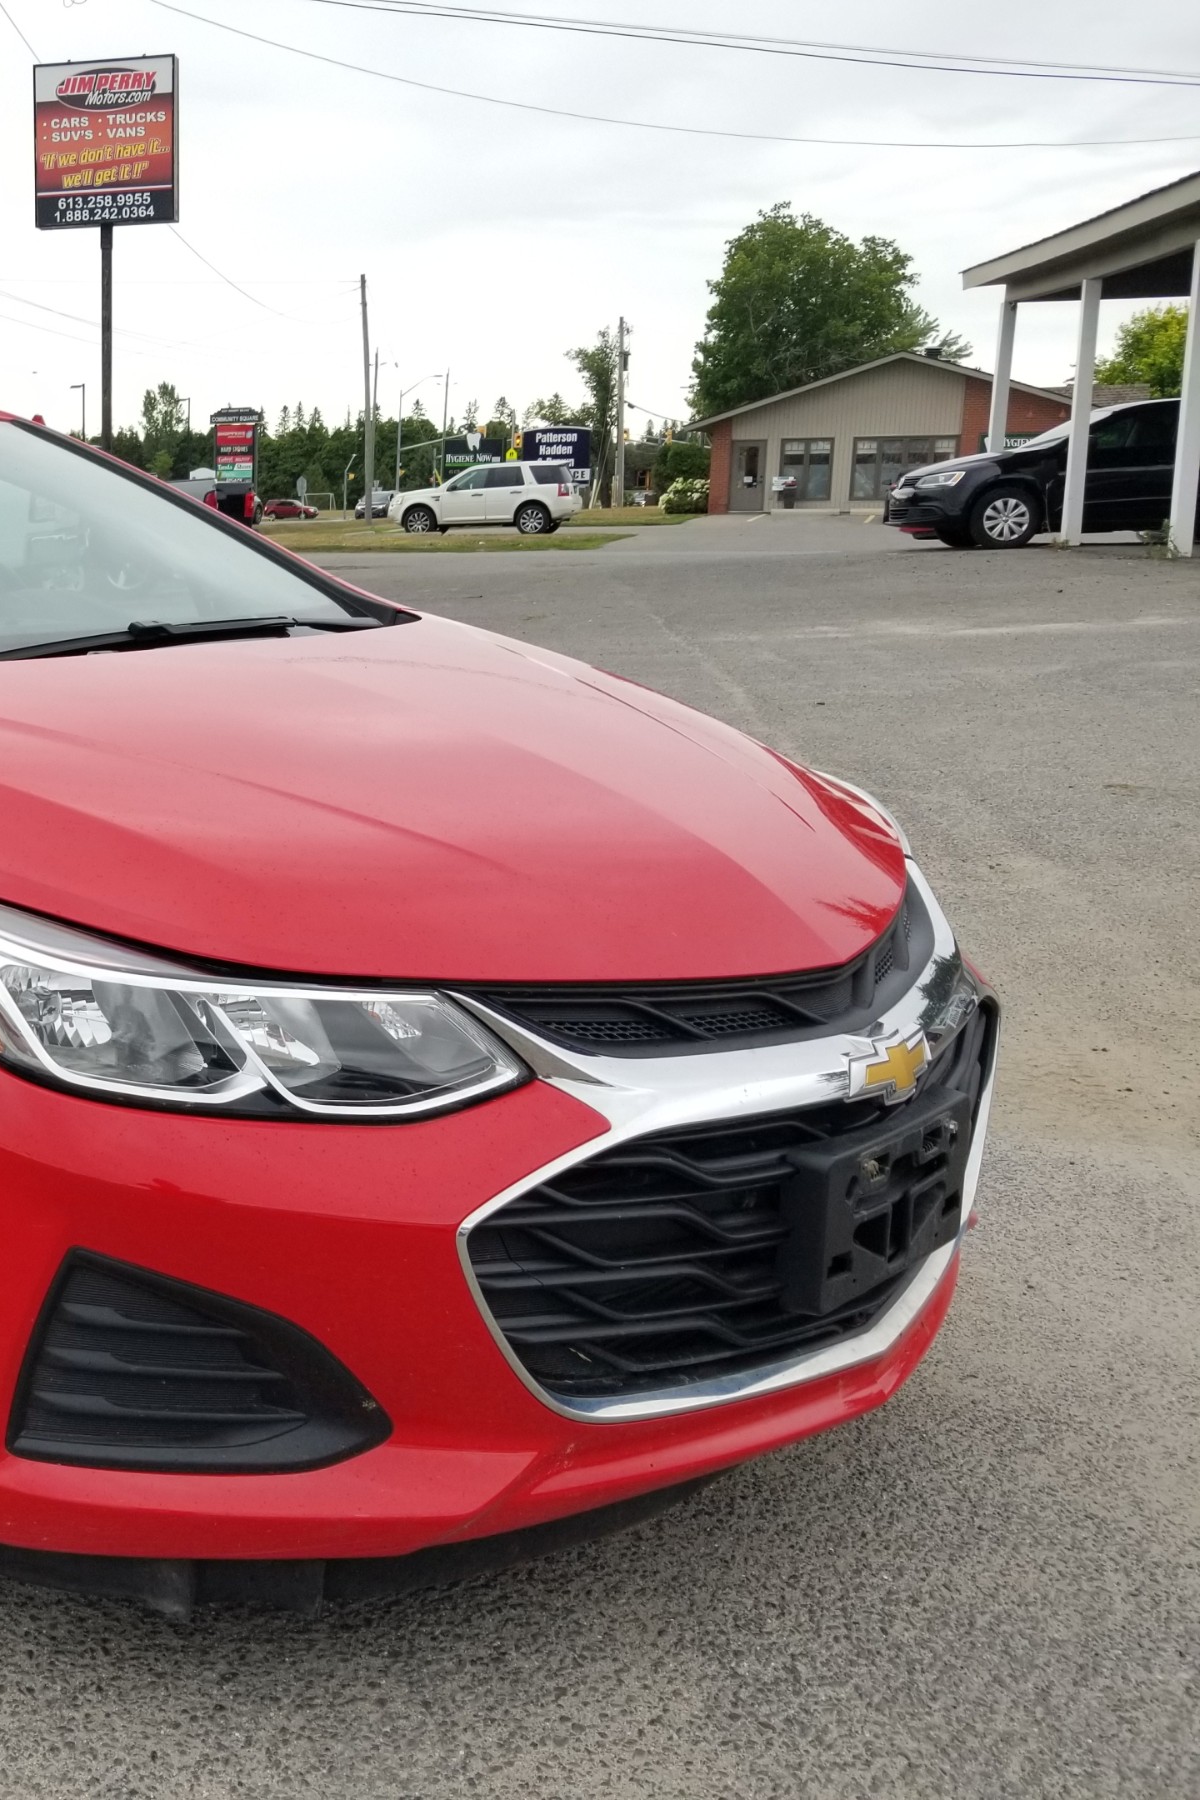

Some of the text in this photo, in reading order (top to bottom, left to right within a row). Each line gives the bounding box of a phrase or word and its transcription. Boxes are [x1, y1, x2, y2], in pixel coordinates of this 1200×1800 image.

[57, 71, 157, 96] JIM PERRY
[85, 90, 151, 106] Motors.com
[51, 111, 166, 129] CARS TRUCKS
[52, 127, 146, 142] SUV'S VANS
[58, 153, 77, 167] we
[79, 145, 113, 165] don't
[114, 143, 146, 159] have
[63, 169, 93, 188] we'll
[94, 166, 118, 186] get
[58, 192, 151, 210] 613.258.9955
[54, 205, 155, 223] 1.888.242.0364
[535, 432, 578, 443] Patterson
[539, 444, 573, 455] Hadden
